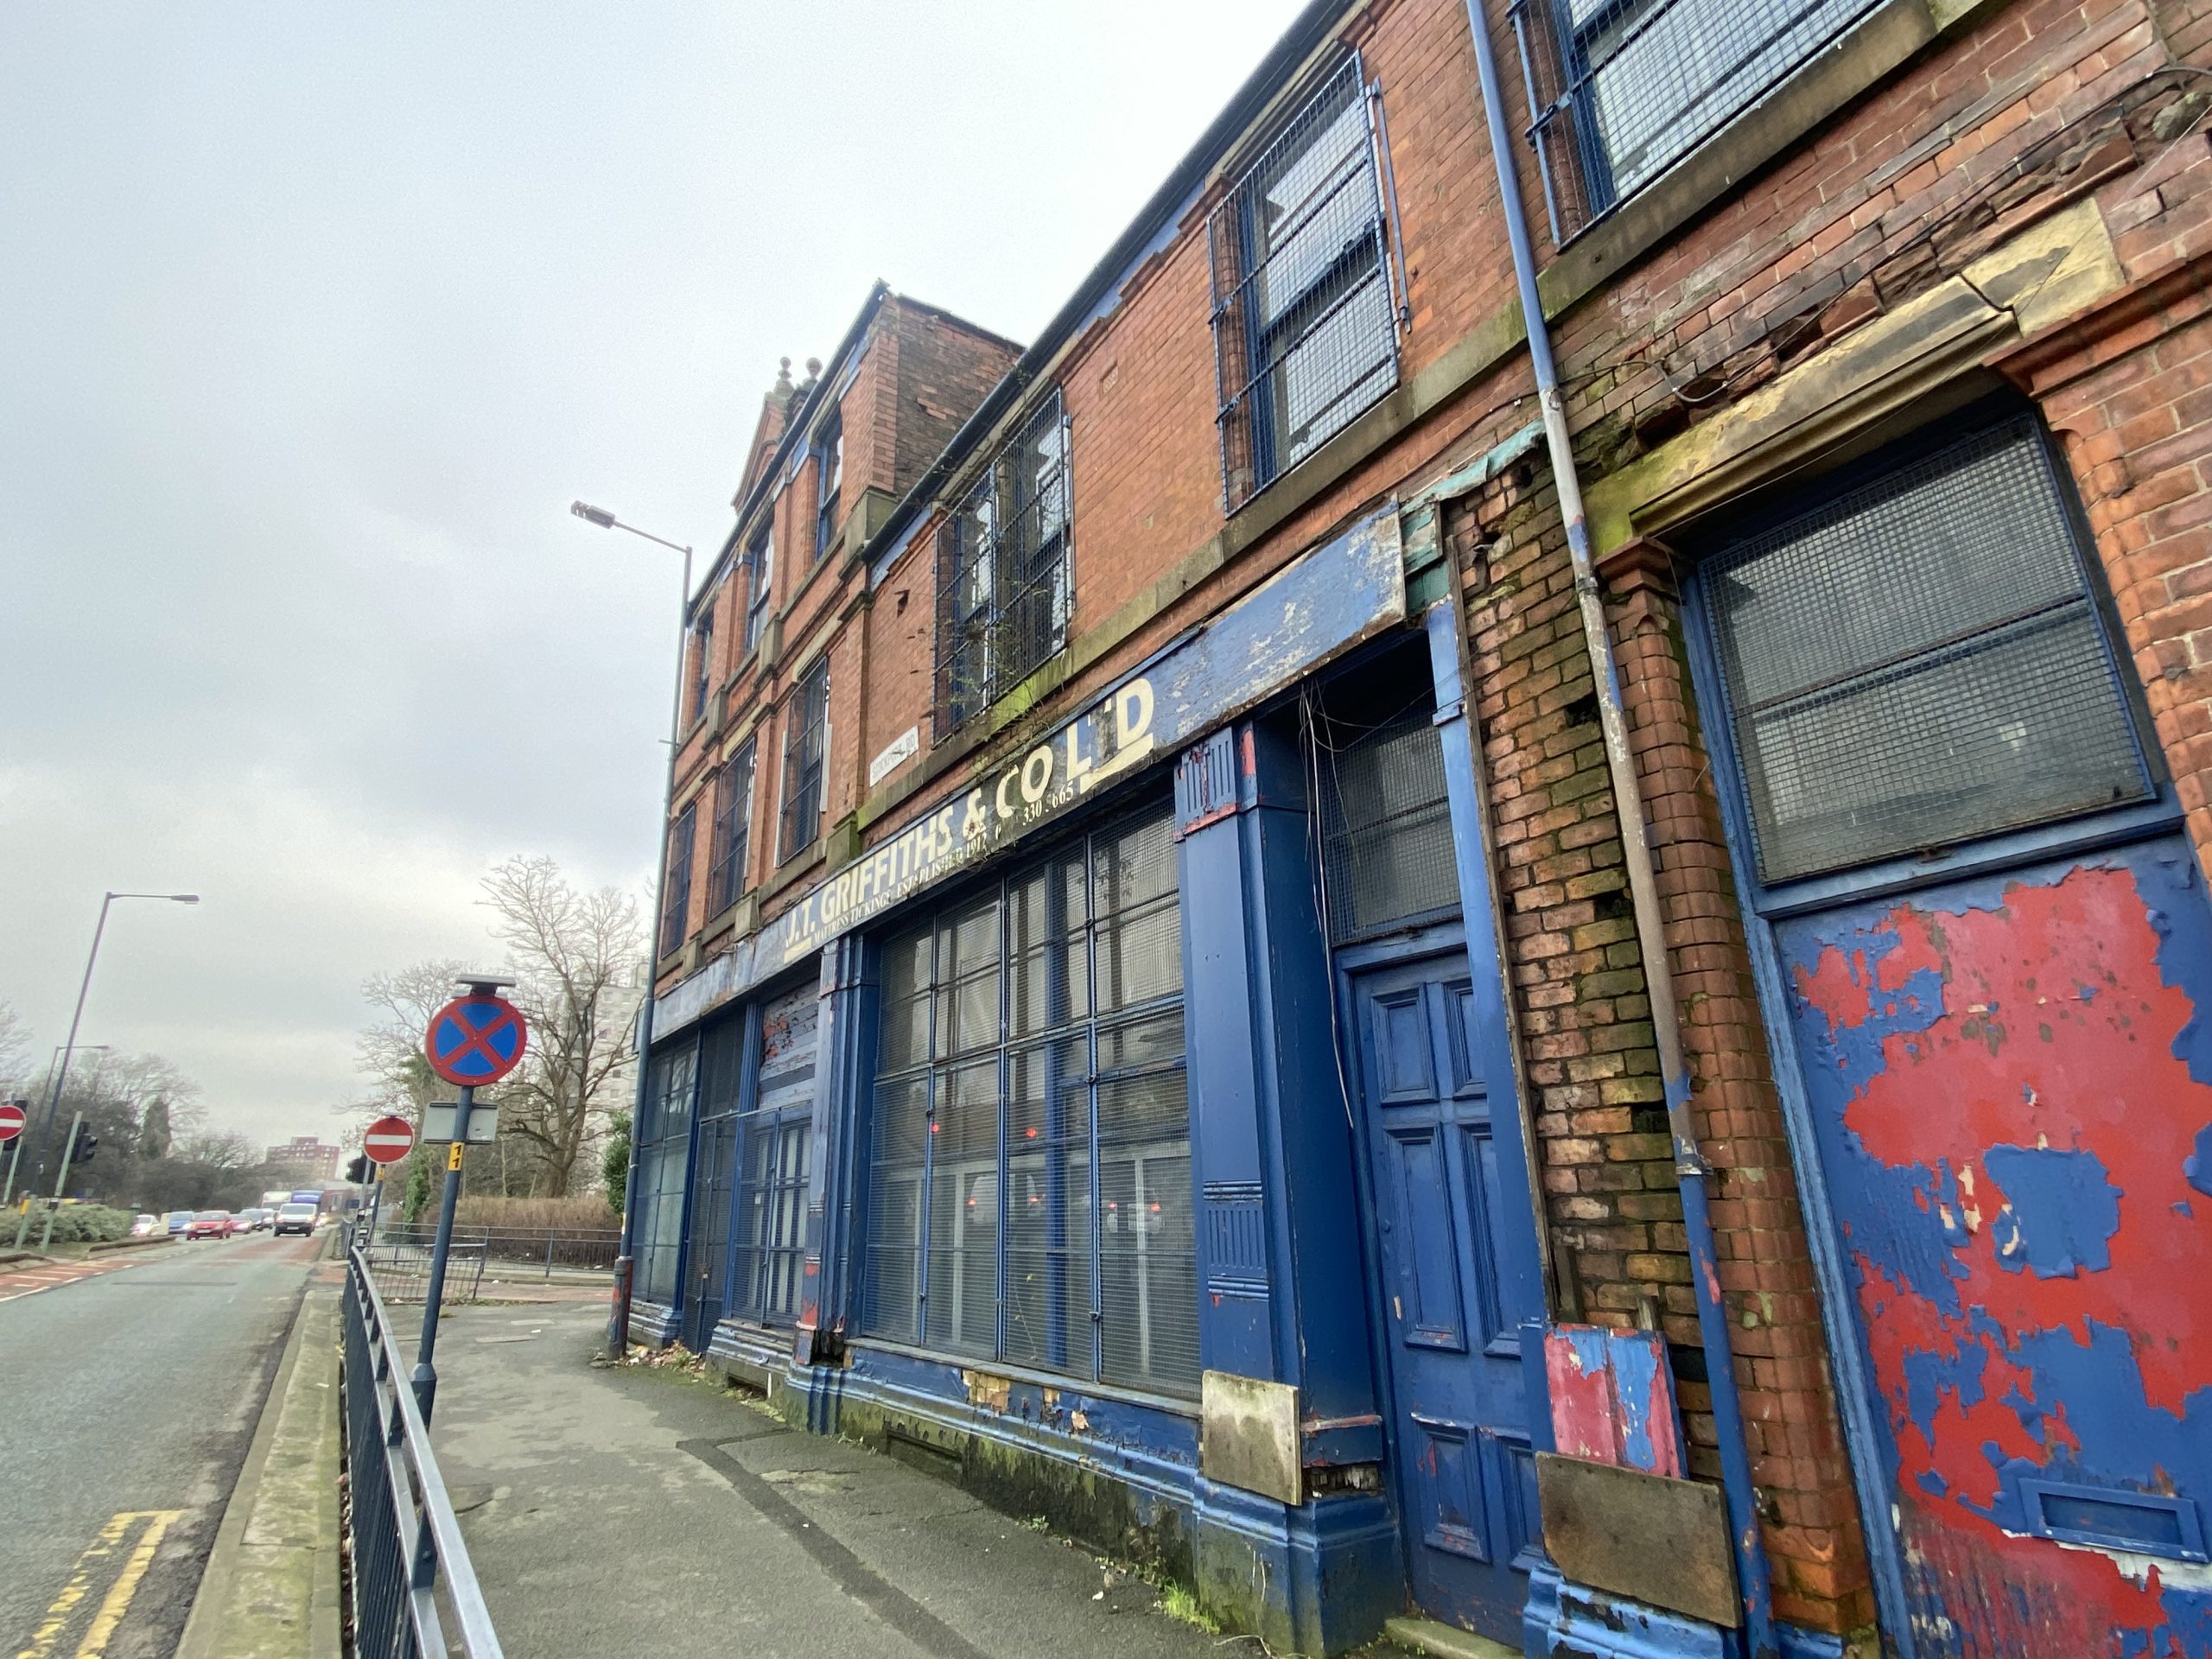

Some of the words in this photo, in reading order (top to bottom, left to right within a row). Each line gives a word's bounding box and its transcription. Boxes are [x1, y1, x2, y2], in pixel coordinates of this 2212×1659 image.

[820, 804, 953, 924] GRIFFITHS
[963, 787, 987, 841] &
[996, 745, 1053, 818] CO
